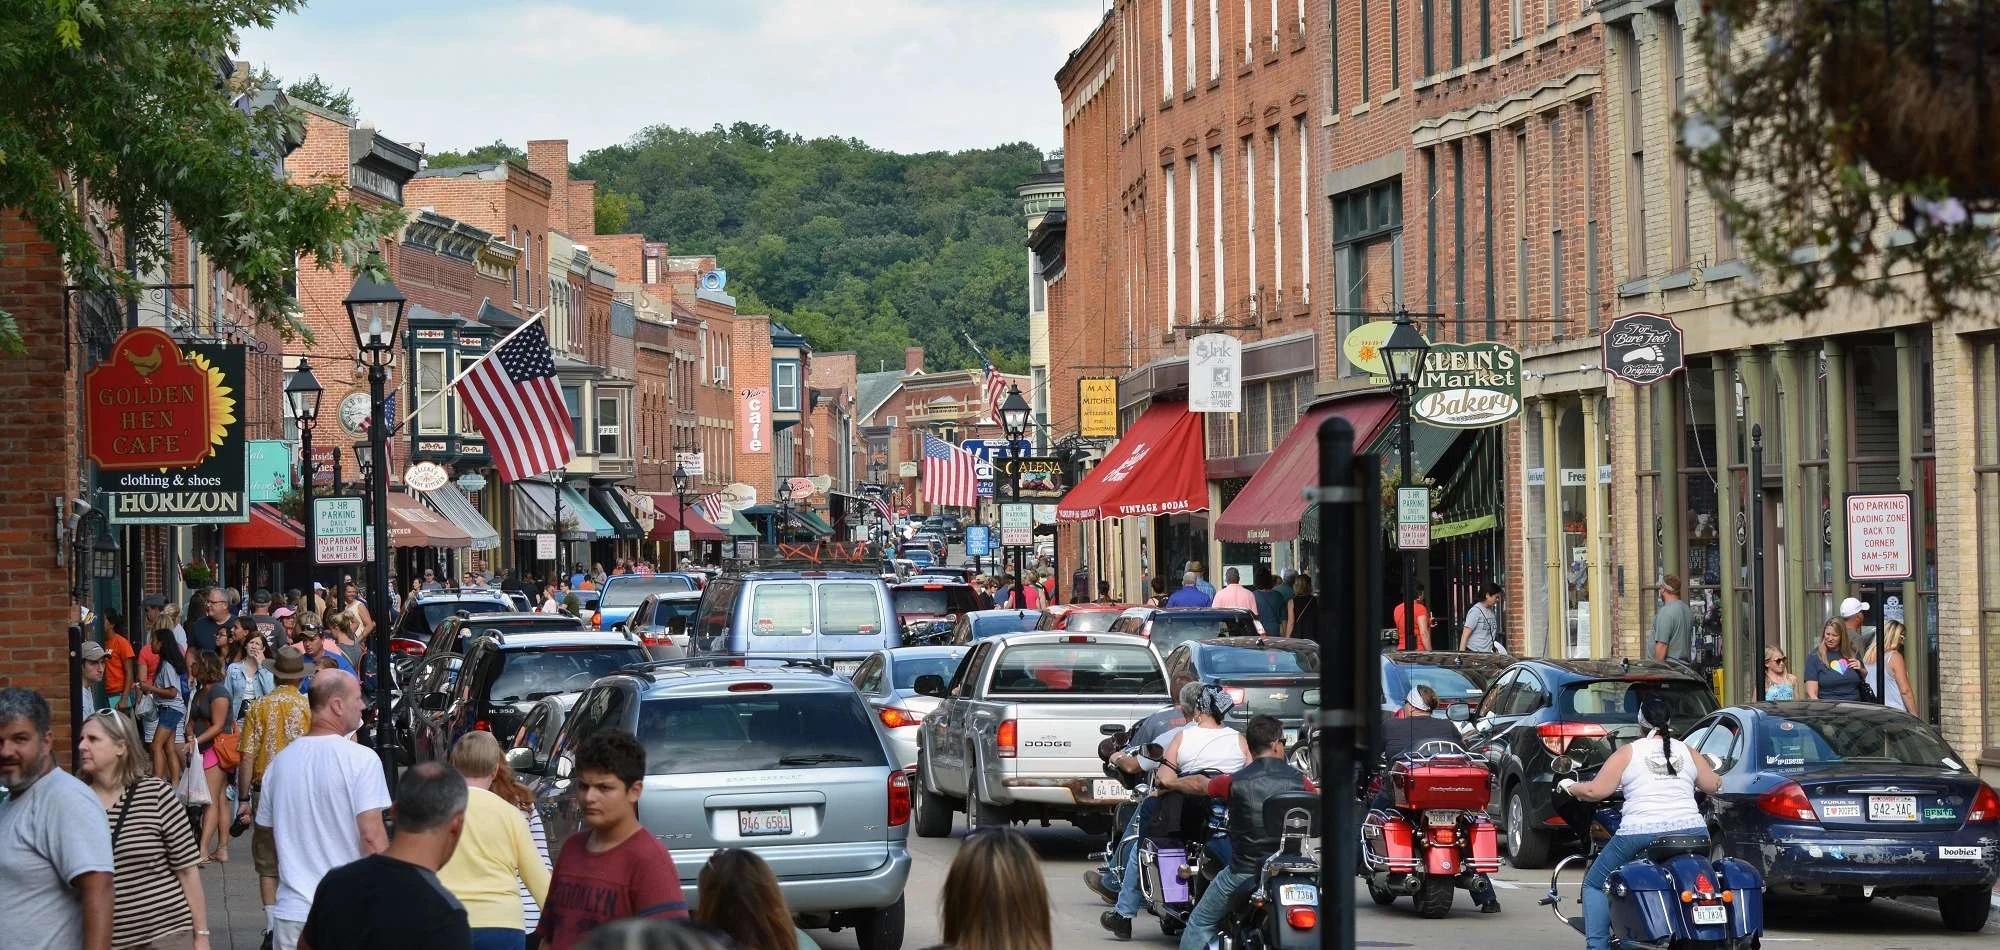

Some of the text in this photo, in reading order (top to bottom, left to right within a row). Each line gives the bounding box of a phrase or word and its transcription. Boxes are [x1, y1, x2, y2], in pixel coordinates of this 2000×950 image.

[1614, 332, 1670, 346] Bare Feet
[1623, 365, 1662, 377] Originals
[1426, 371, 1516, 388] Market
[1087, 384, 1111, 392] MAX
[99, 385, 195, 405] GOLDEN
[1210, 391, 1232, 400] STAMP
[1420, 388, 1514, 418] Bakery
[121, 411, 174, 429] HEN
[120, 474, 221, 488] clothing & shoes
[1119, 500, 1189, 514] VINTAGE SODAS
[1853, 501, 1904, 511] NO PARKING
[321, 510, 356, 520] PARKING
[1851, 514, 1906, 524] LOADING ZONE
[1863, 527, 1896, 535] BACK TO
[1865, 539, 1895, 548] CORNER
[1861, 552, 1899, 560] 8AM-5PM
[1863, 564, 1898, 573] MON-FRI
[1024, 740, 1072, 748] DODGE
[1873, 803, 1912, 816] 942-XAC
[741, 816, 789, 831] 946 6581
[1943, 848, 1977, 856] boobies!
